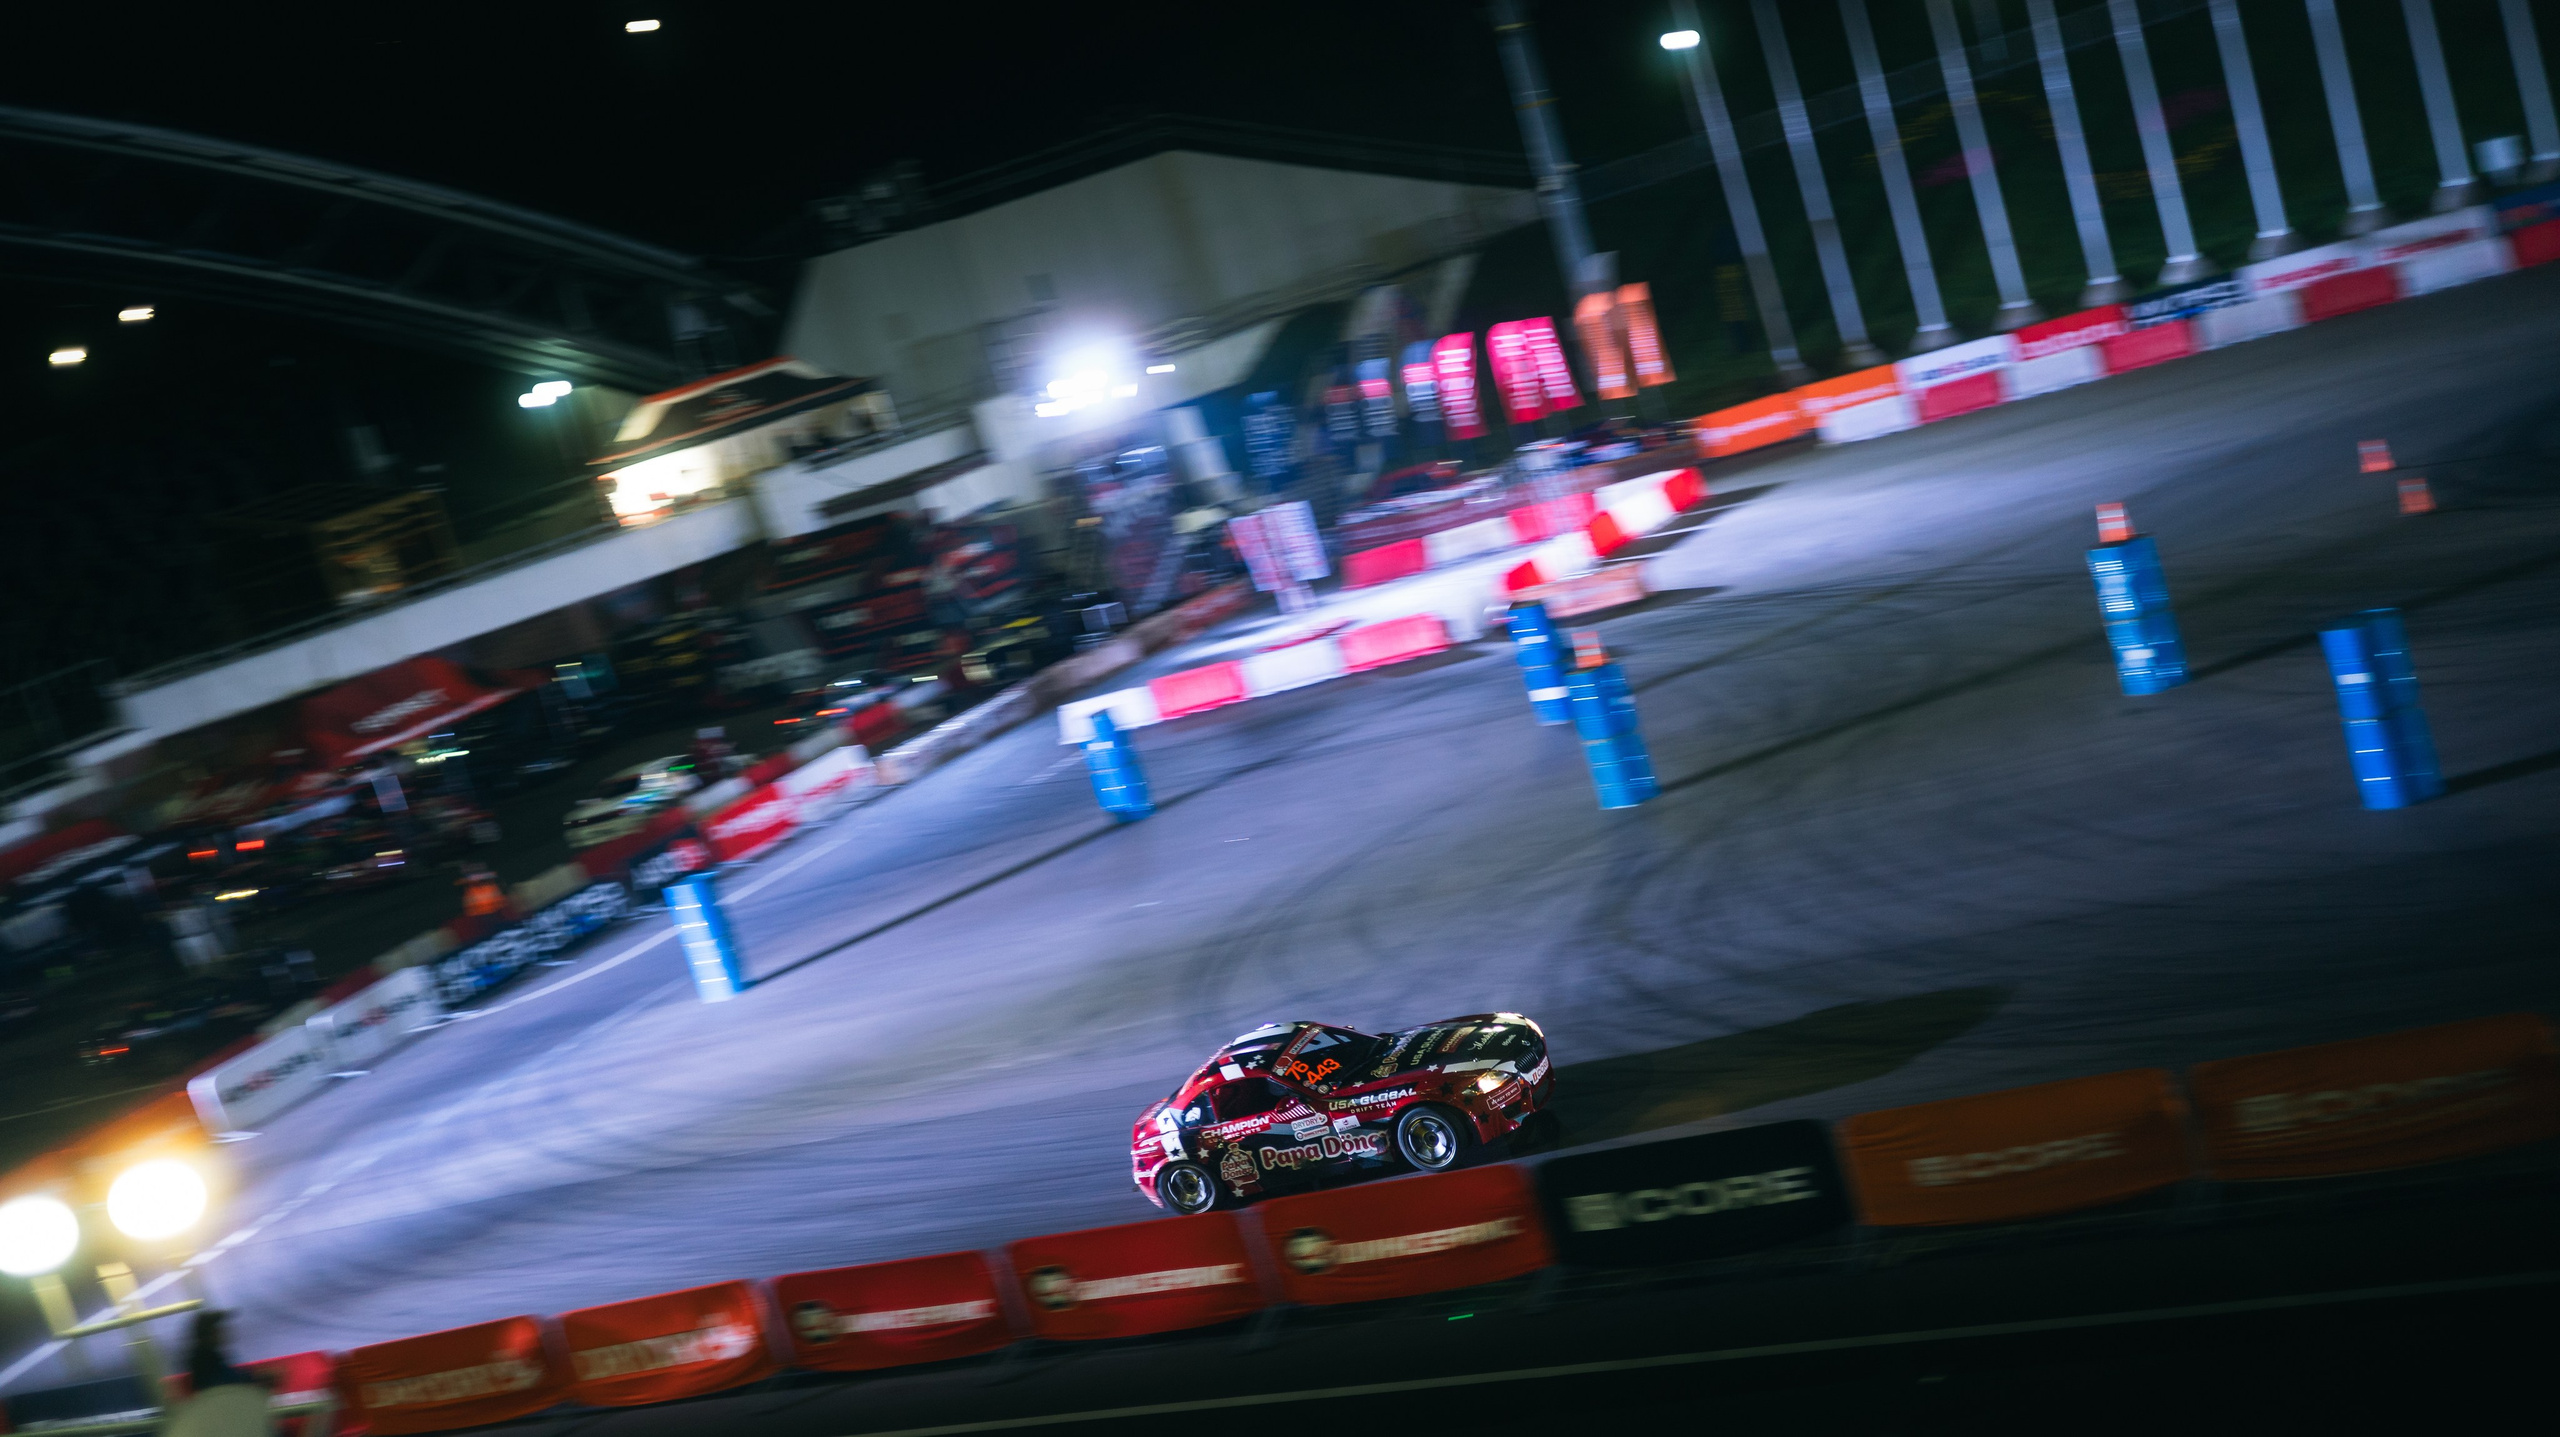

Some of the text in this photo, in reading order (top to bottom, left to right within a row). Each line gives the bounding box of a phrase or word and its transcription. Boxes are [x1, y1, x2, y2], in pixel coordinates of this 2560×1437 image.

[1284, 1059, 1310, 1081] 76
[1306, 1058, 1341, 1085] 443
[1328, 1088, 1417, 1112] USA GLOBAL
[1350, 1101, 1397, 1114] DRIFT TEAM
[1201, 1115, 1271, 1139] CHAMPION
[1292, 1117, 1318, 1129] DRYDRY
[1221, 1158, 1248, 1171] Papa
[1261, 1143, 1321, 1169] Papa
[1620, 1164, 1821, 1223] CORE
